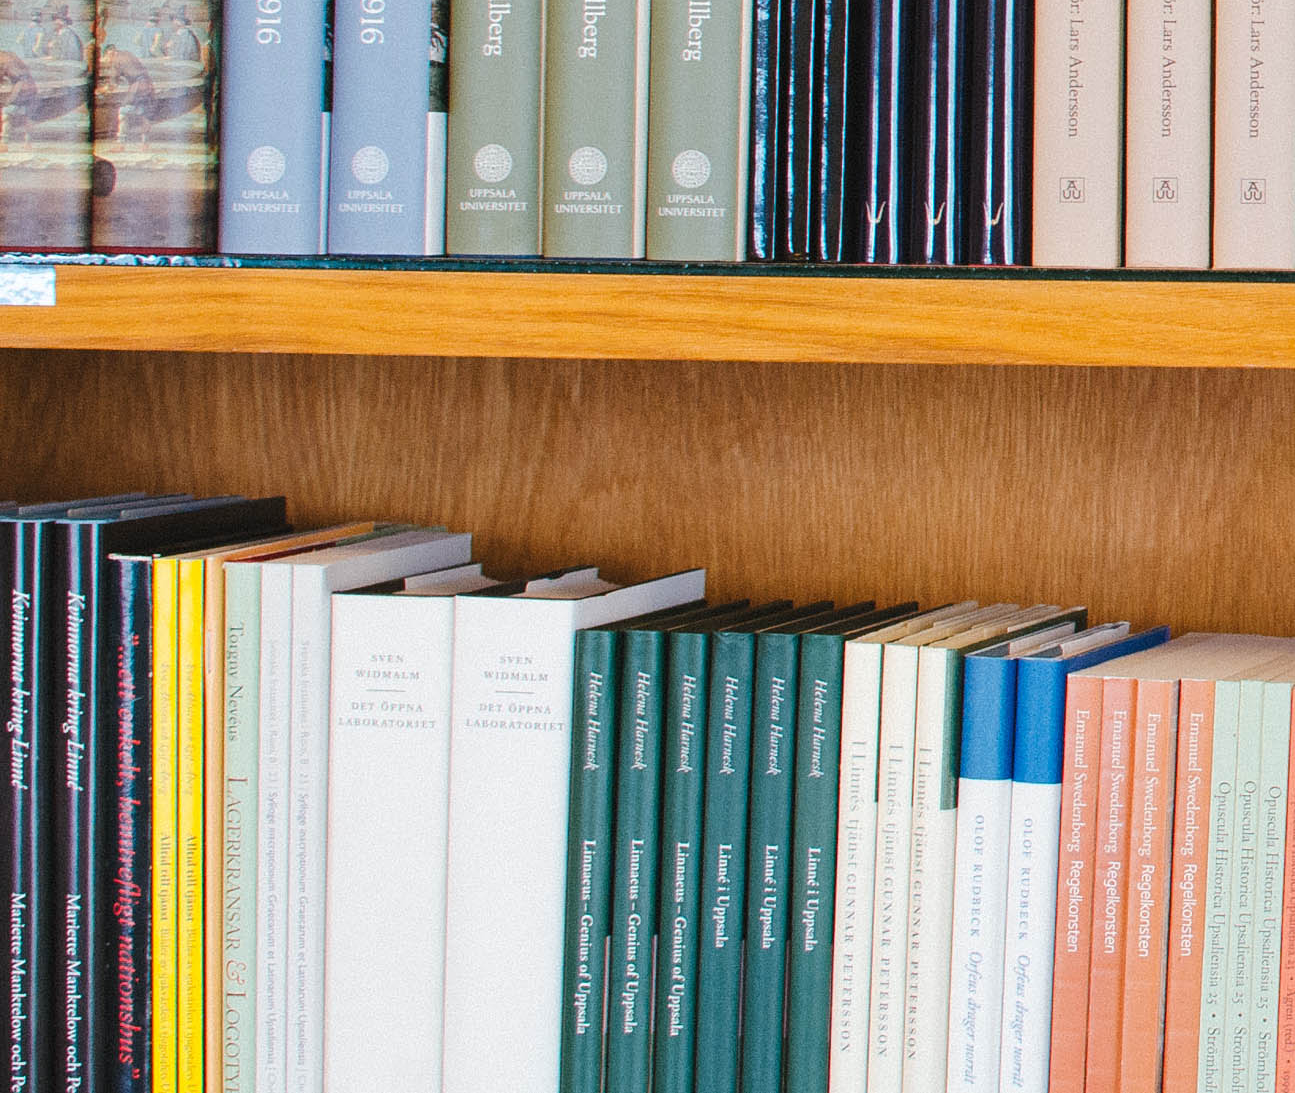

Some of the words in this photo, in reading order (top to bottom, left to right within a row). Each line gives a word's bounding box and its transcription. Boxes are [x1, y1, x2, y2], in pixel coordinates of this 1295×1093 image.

[66, 591, 85, 684] Kvinnorna
[62, 688, 85, 734] kring
[769, 676, 784, 719] Helena
[66, 739, 84, 791] Linné
[766, 724, 783, 776] Harnesk
[1072, 710, 1091, 769] Emanuel
[1066, 772, 1087, 852] Swedenborg
[764, 845, 779, 885] Linné
[761, 896, 776, 948] Uppsala
[1066, 860, 1083, 952] Regelkonsten
